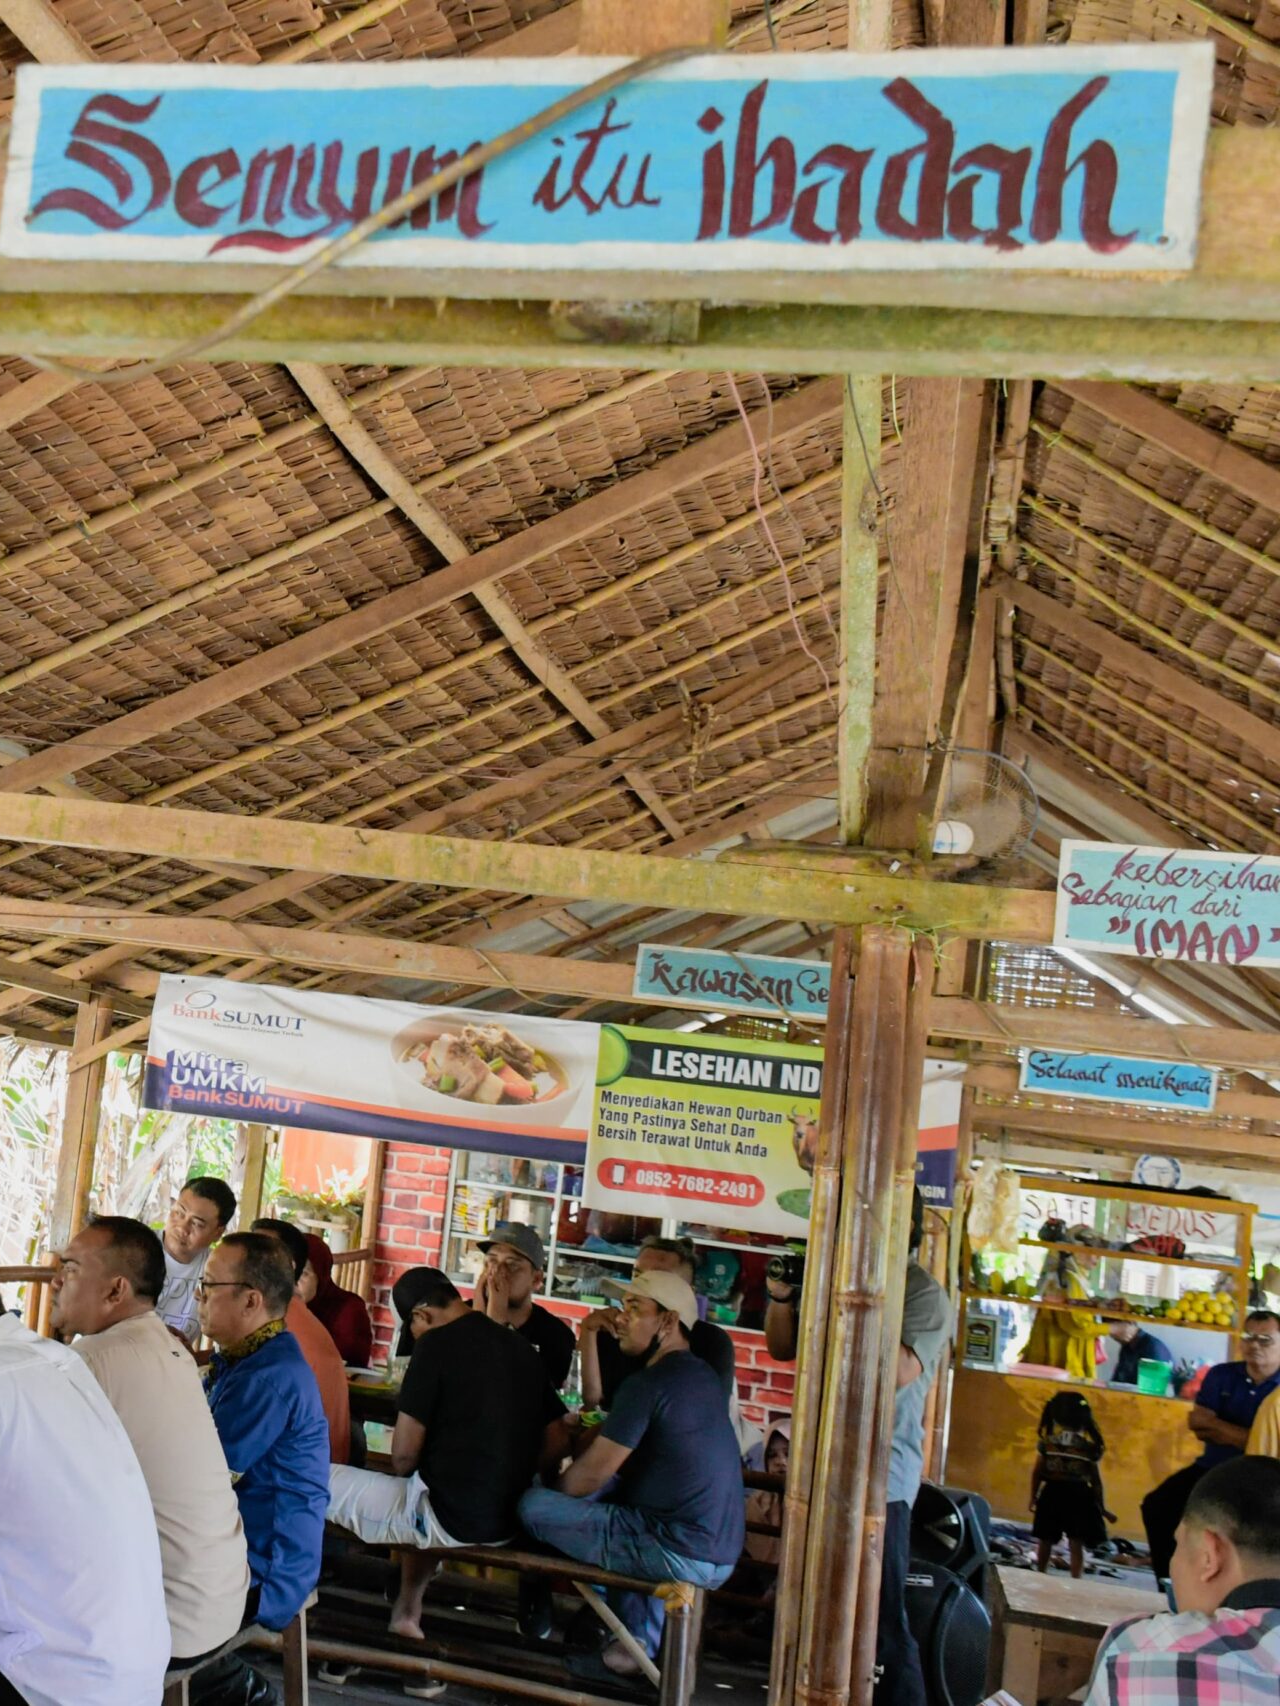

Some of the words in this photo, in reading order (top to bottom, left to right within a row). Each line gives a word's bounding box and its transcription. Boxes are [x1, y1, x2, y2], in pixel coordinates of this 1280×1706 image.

[24, 93, 498, 256] Senyum
[533, 98, 660, 215] itu
[697, 75, 1138, 253] ibadah
[1061, 872, 1178, 918] Sebagian
[1188, 892, 1242, 918] dari
[796, 969, 830, 1004] Se
[173, 1049, 249, 1075] Mitra
[651, 1048, 773, 1088] LESEHAN
[780, 1063, 821, 1093] ND
[1027, 1050, 1114, 1084] Selamat
[170, 1066, 267, 1095] UMKM
[599, 1107, 629, 1125] Yang
[633, 1111, 686, 1131] Pastinya
[690, 1118, 727, 1135] Sehat
[730, 1123, 756, 1139] Dan
[600, 1090, 685, 1113] Menyediakan
[688, 1100, 732, 1118] Hewan
[736, 1106, 783, 1124] Qurban
[597, 1124, 637, 1142] Bersih
[641, 1130, 691, 1148] Terawat
[694, 1137, 732, 1153] Untuk
[734, 1142, 768, 1158] Anda
[636, 1168, 756, 1200] 0852-7682-2491
